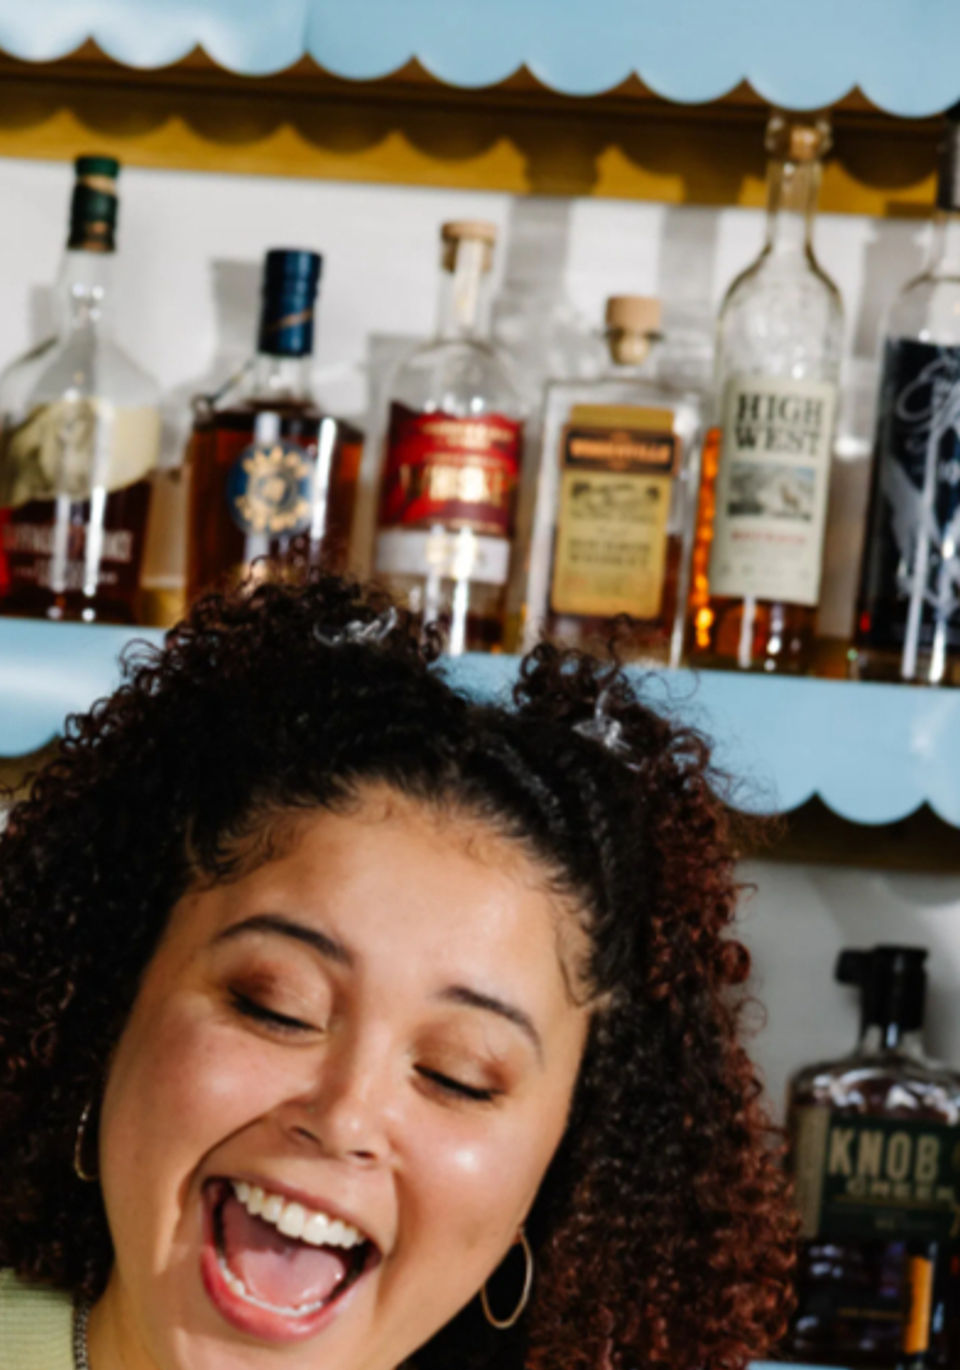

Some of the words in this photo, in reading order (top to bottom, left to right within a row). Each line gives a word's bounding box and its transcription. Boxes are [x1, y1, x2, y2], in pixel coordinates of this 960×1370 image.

[736, 393, 823, 426] HIGH
[734, 425, 820, 456] WEST
[828, 1127, 941, 1182] KNOB
